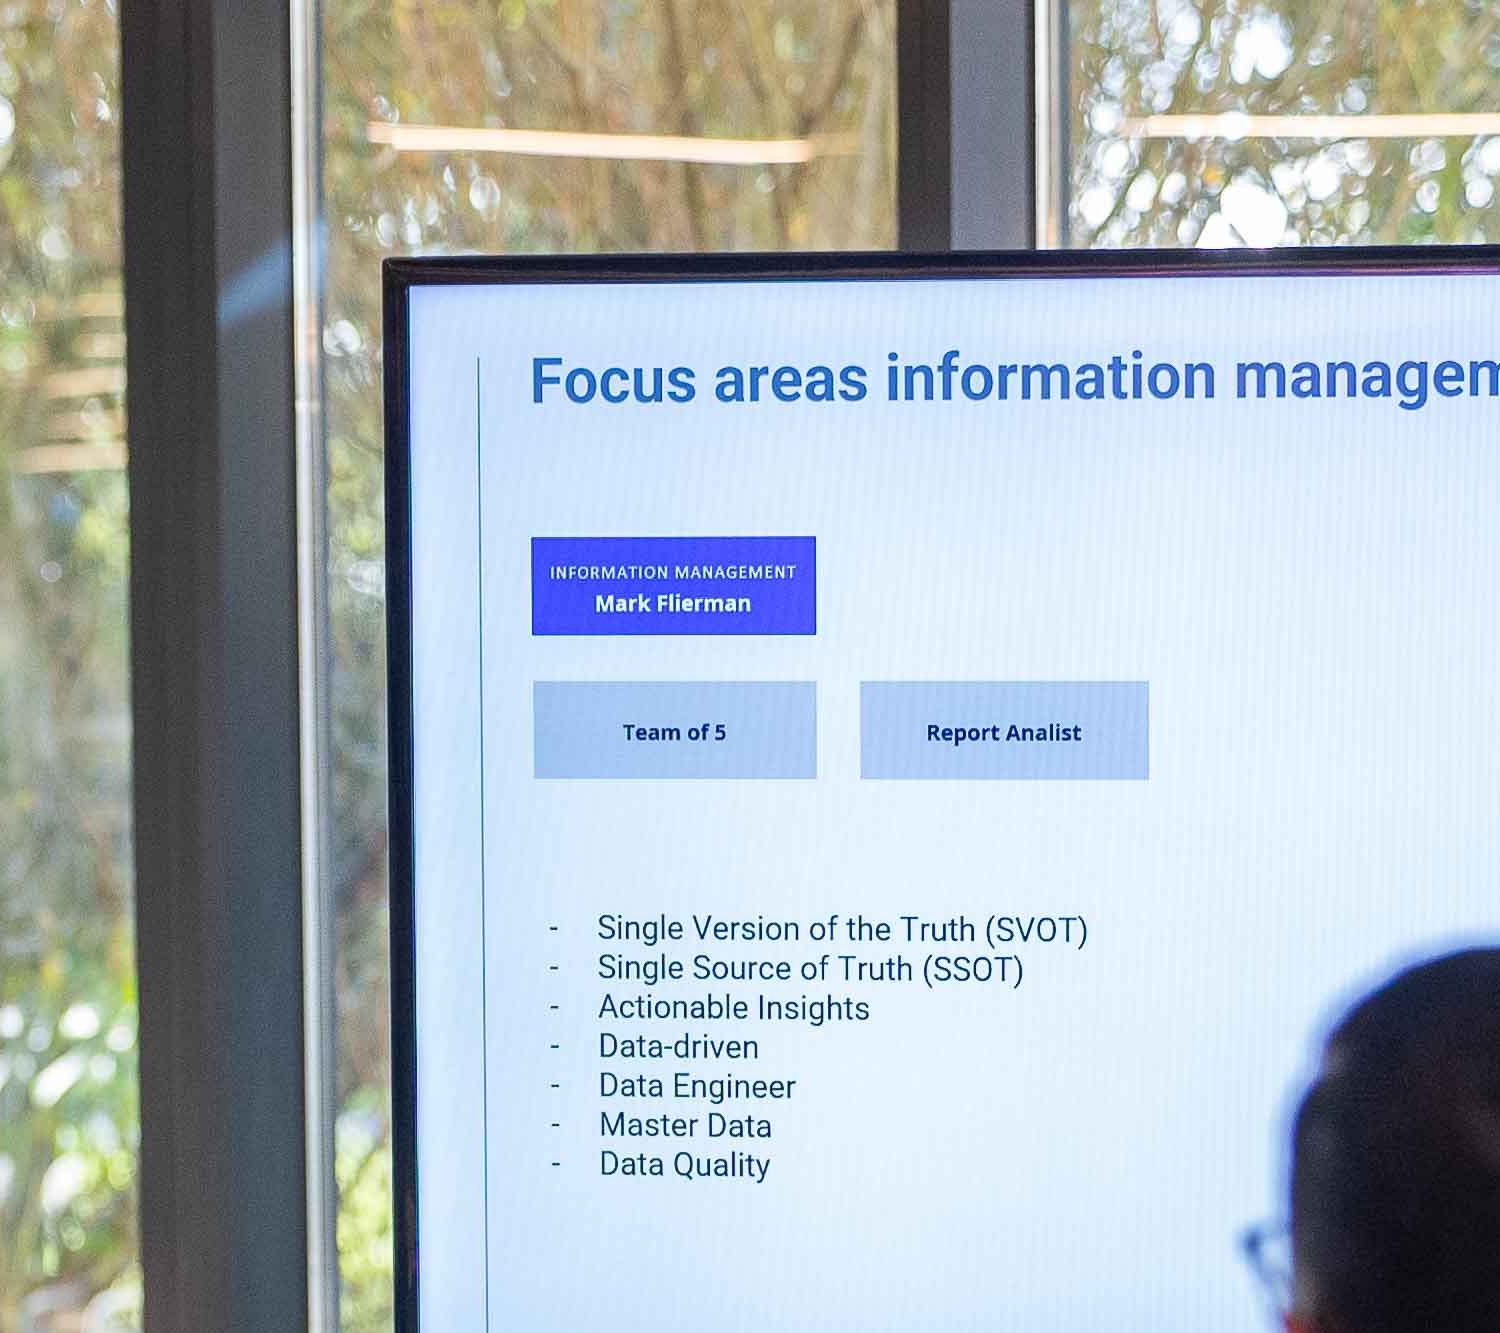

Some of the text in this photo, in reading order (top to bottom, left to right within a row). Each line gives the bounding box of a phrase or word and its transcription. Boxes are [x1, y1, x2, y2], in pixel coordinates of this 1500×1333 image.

[532, 357, 696, 404] Focus
[715, 365, 868, 403] areas
[887, 349, 1215, 401] information
[550, 565, 797, 580] INFORMATION MANAGEMENT
[595, 593, 751, 613] Mark Flierman
[622, 723, 726, 741] Team of 5
[927, 723, 1082, 747] Report Analist
[598, 913, 1087, 950] Single Version of the Truth (SVOT)
[598, 953, 1023, 989] Single Source of Truth (SSOT)
[598, 993, 870, 1027] Actionable Insights
[600, 1032, 758, 1059] Data-driven
[600, 1072, 797, 1105] Data Engineer
[600, 1111, 772, 1138] Master Data
[601, 1150, 771, 1184] Data Quality
